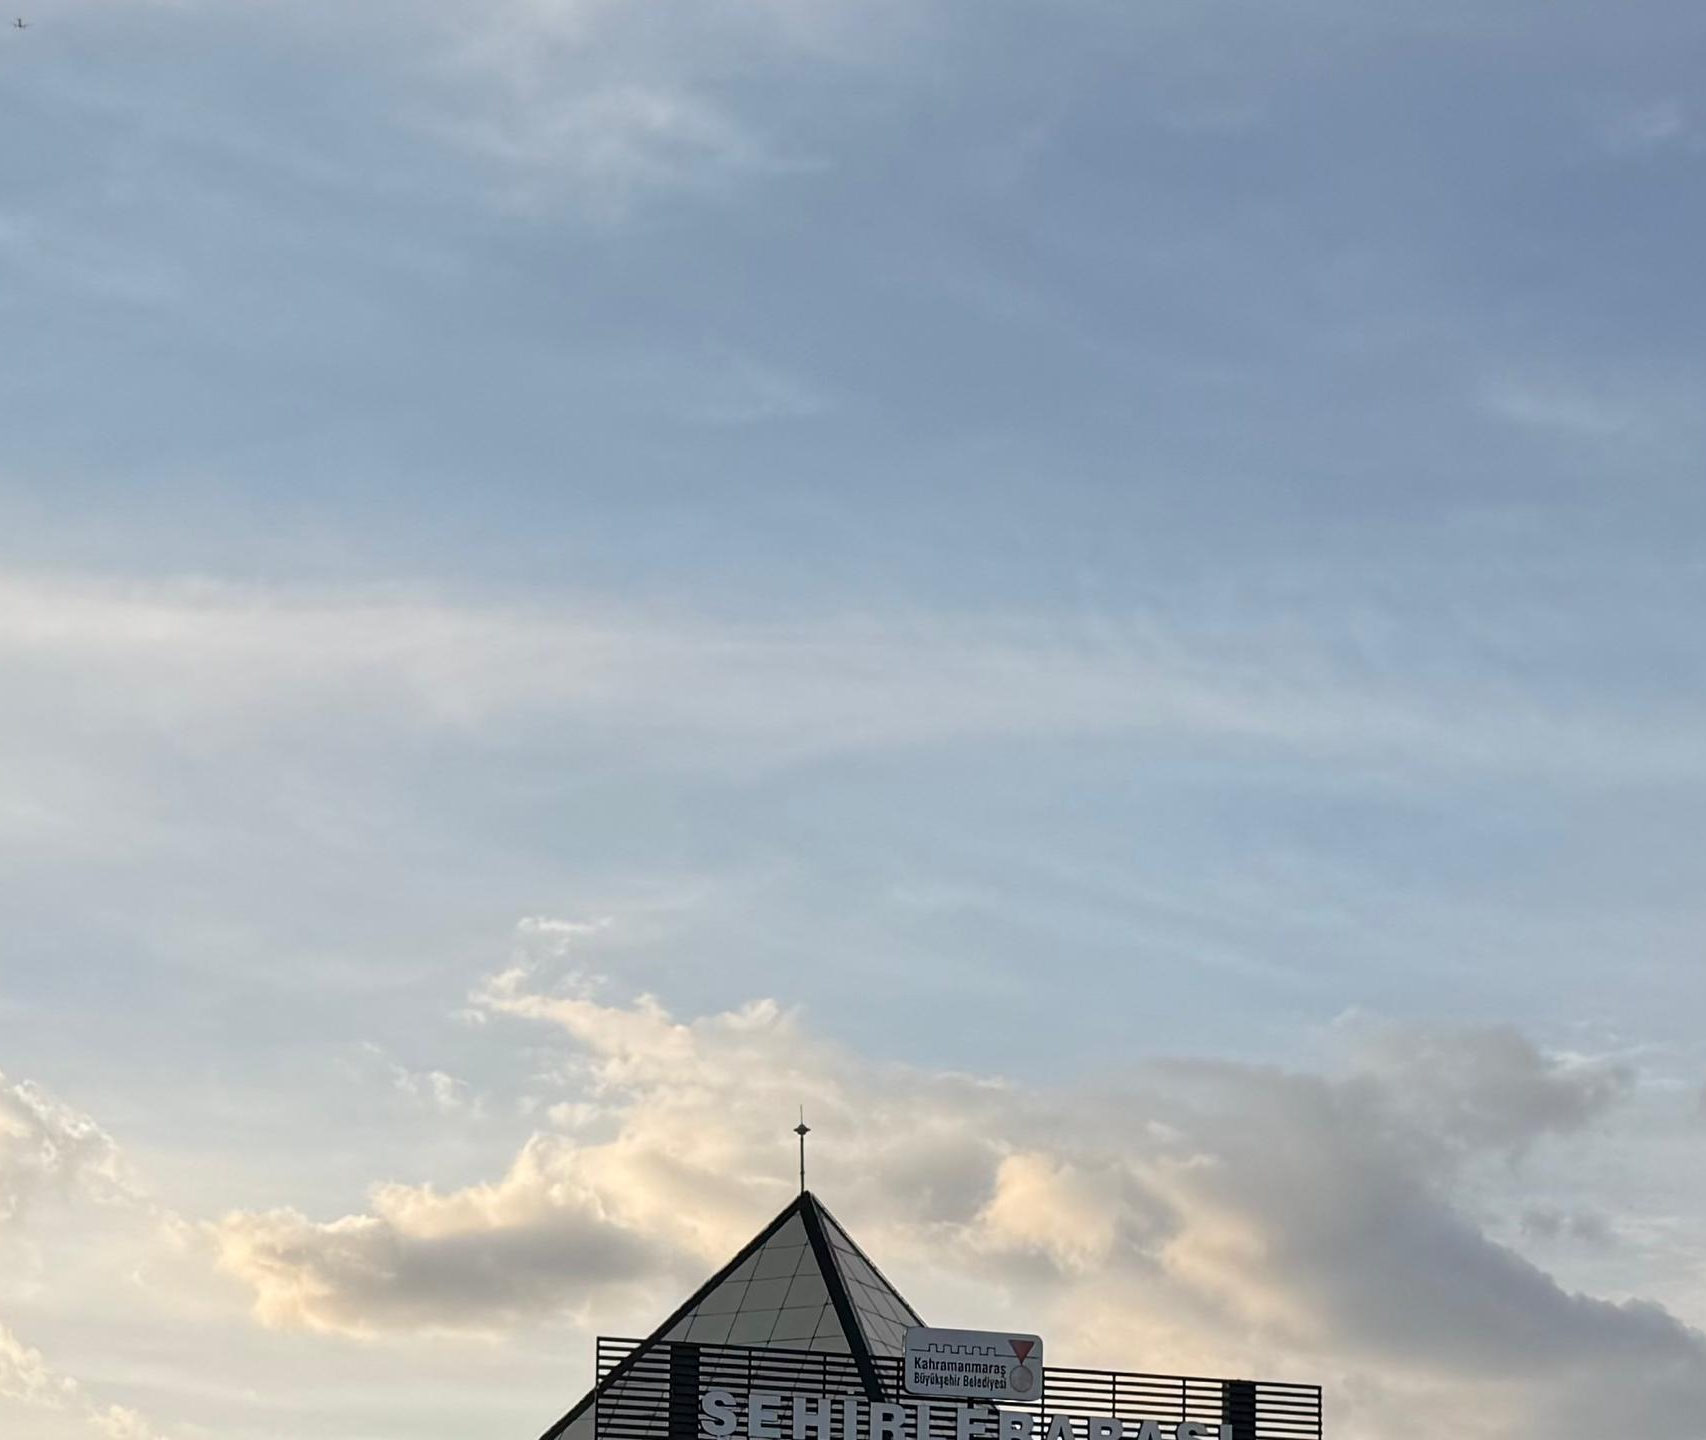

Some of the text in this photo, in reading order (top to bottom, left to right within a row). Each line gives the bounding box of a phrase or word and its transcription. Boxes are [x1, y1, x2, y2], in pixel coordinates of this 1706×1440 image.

[914, 1357, 1006, 1378] Kahramanmaraş
[914, 1372, 1007, 1391] Büyükşehir Belediyesi
